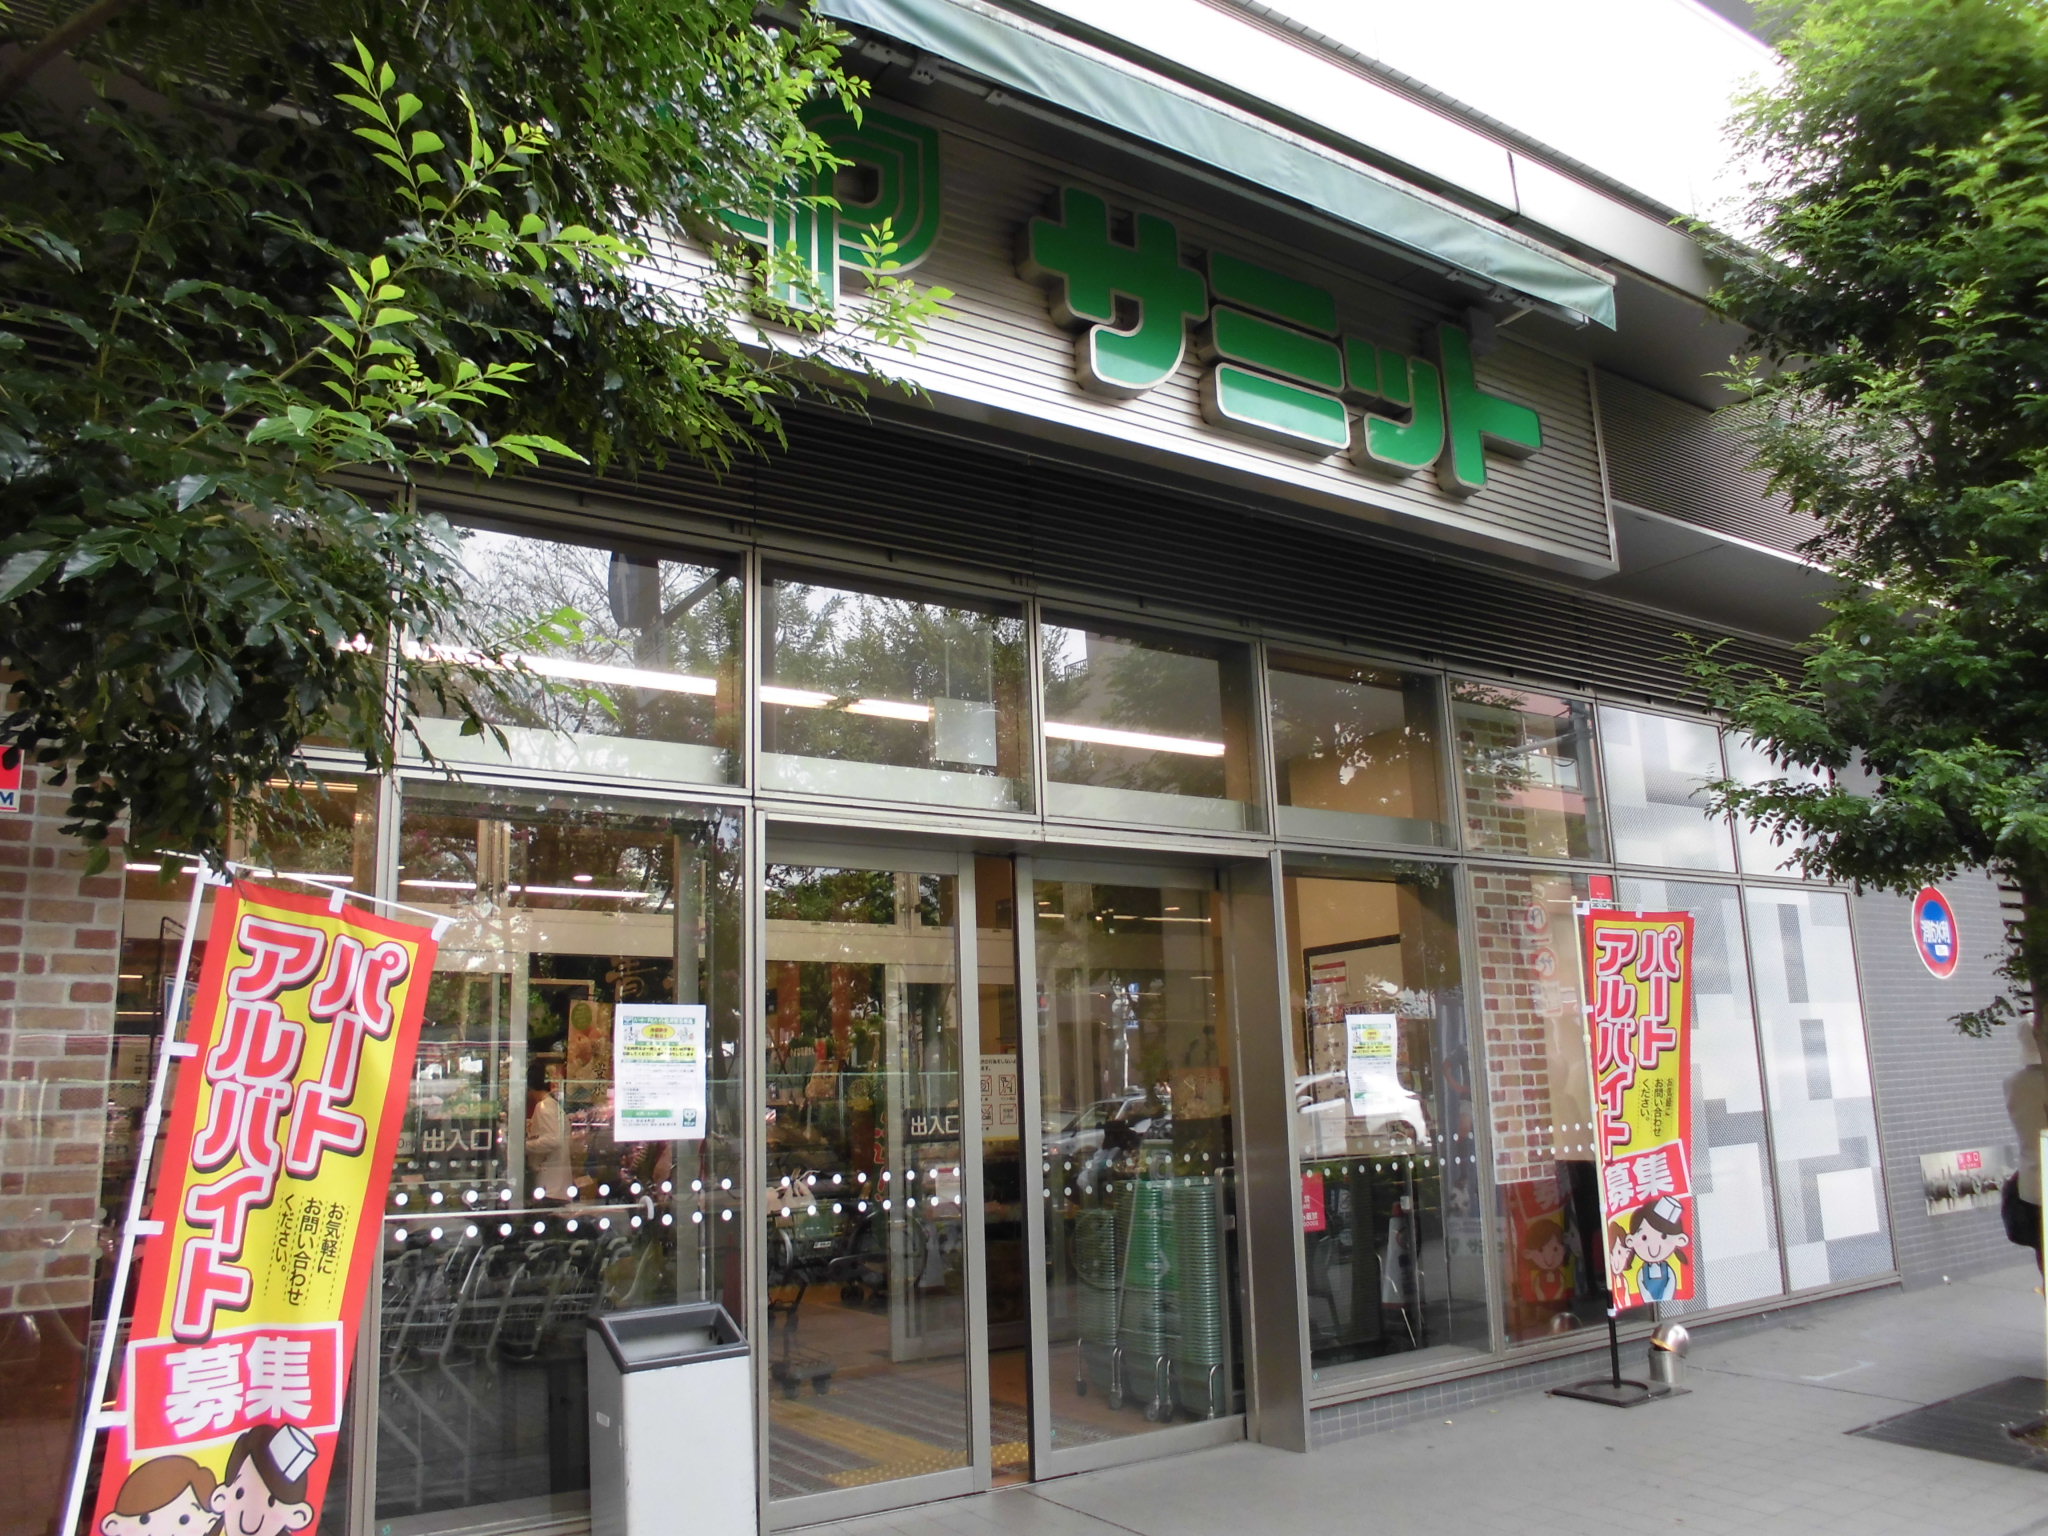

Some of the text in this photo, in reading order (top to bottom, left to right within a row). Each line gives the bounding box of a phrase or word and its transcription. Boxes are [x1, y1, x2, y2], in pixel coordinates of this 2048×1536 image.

[1026, 186, 1543, 496] サミット
[1595, 928, 1638, 1161] アルバイト
[1638, 925, 1683, 1068] パート
[287, 936, 409, 1175] パート
[1640, 1078, 1650, 1121] ください。
[173, 915, 327, 1340] アルバイト
[422, 1128, 493, 1152] 出入口
[1653, 1078, 1664, 1137] お問い合わせ
[274, 1193, 294, 1273] ください。
[1604, 1151, 1674, 1213] 募集
[287, 1198, 323, 1306] お問い合わせ
[316, 1201, 344, 1274] お気軽に
[165, 1336, 312, 1438] 募集
